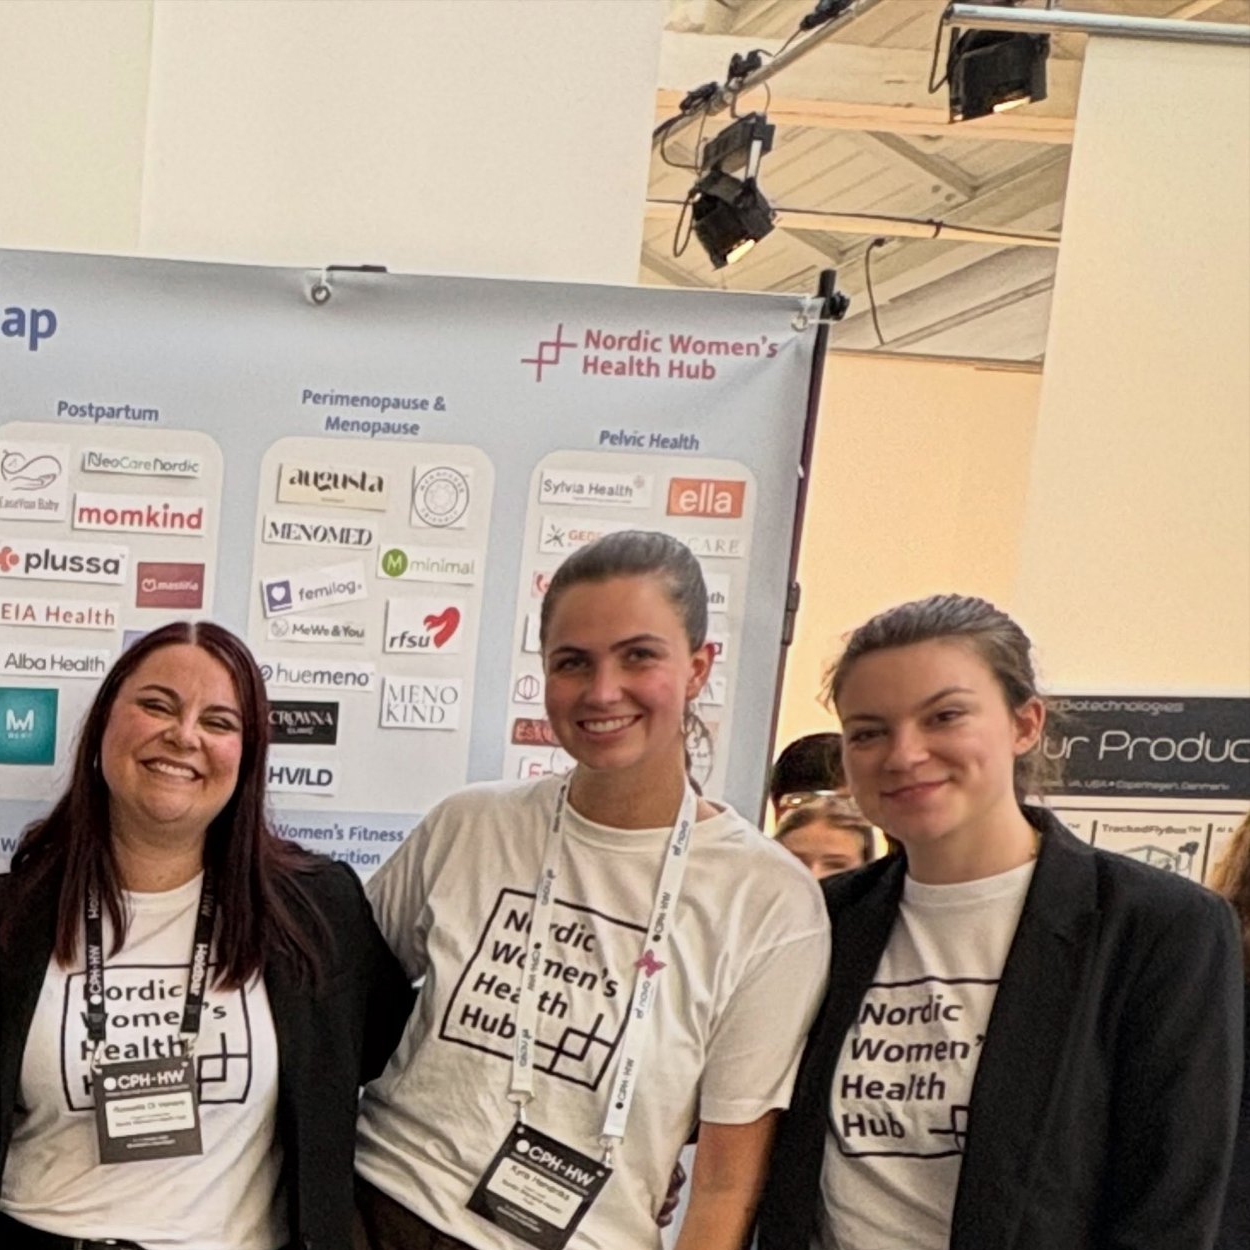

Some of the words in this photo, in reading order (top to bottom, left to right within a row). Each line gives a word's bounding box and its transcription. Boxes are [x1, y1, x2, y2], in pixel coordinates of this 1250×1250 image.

[584, 329, 663, 354] Nordic
[669, 334, 780, 359] Women's
[582, 355, 661, 378] Health
[667, 359, 716, 380] Hub
[57, 400, 159, 424] Postpartum
[302, 389, 430, 413] Perimenopause
[433, 396, 447, 412] &
[325, 415, 421, 438] Menopause
[599, 430, 645, 448] Pelvic
[649, 433, 700, 451] Health
[153, 458, 200, 473] Nordic
[543, 479, 584, 495] Sylvia
[588, 482, 634, 498] Health
[679, 481, 733, 515] ella
[77, 503, 203, 530] momkind
[268, 521, 373, 546] MENOMED
[24, 548, 120, 575] plussa
[409, 557, 475, 575] minimal
[45, 605, 115, 626] Health
[388, 630, 431, 649] rfsu
[4, 652, 47, 671] Alba
[50, 654, 106, 672] Health
[276, 662, 370, 687] huemeno
[388, 684, 459, 705] MENO
[385, 703, 446, 724] KIND
[1041, 735, 1090, 760] ur
[268, 765, 333, 787] HVILD
[349, 826, 404, 842] Fitness
[328, 848, 381, 865] trition
[503, 909, 598, 953] Ndic
[104, 979, 183, 1002] ordic
[472, 971, 569, 1020] Heth
[80, 1001, 228, 1030] ome's
[459, 1003, 517, 1040] Hub
[860, 994, 964, 1026] Nordic
[851, 1034, 986, 1064] Women'
[841, 1072, 946, 1102] Health
[842, 1112, 906, 1139] Hub
